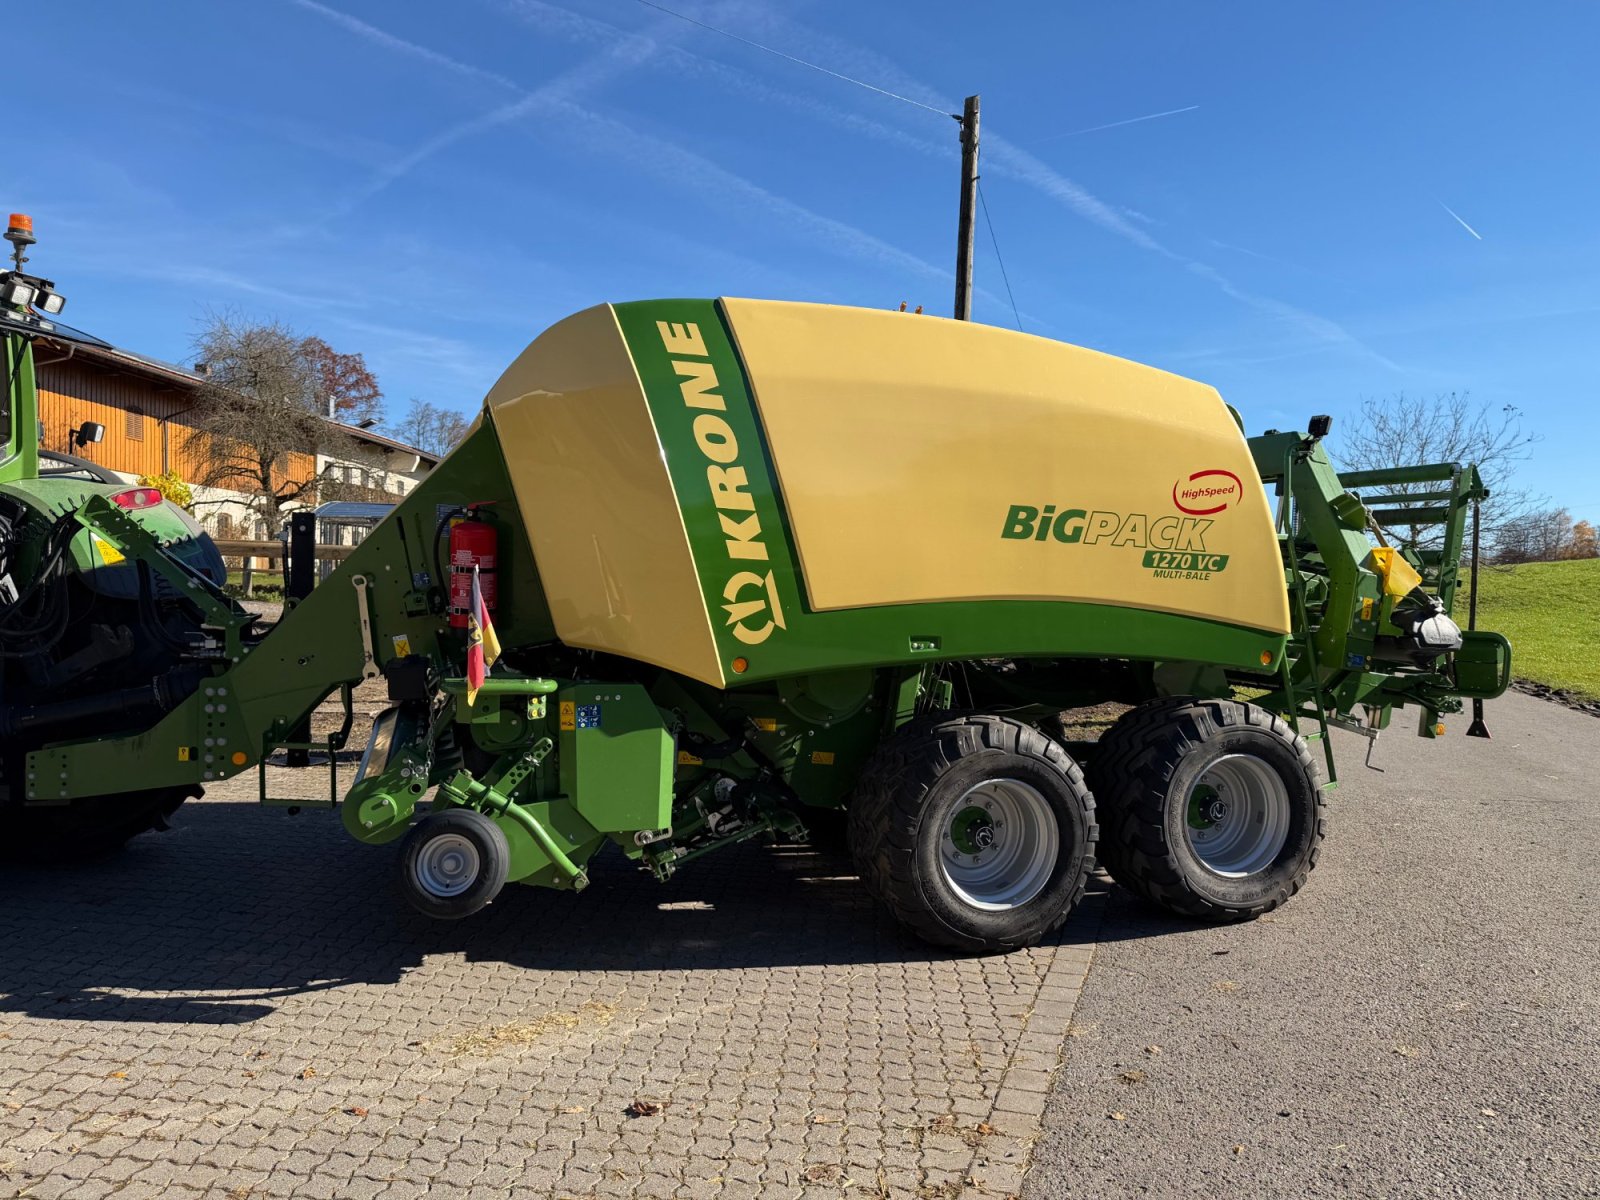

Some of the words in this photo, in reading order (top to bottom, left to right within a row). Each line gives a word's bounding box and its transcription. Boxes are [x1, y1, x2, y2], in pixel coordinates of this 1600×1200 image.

[655, 320, 769, 561] KRONE
[1181, 485, 1235, 500] HighSpeed
[1152, 552, 1192, 569] 1270
[1197, 555, 1221, 571] VC
[1152, 569, 1211, 581] MULTI-BALE
